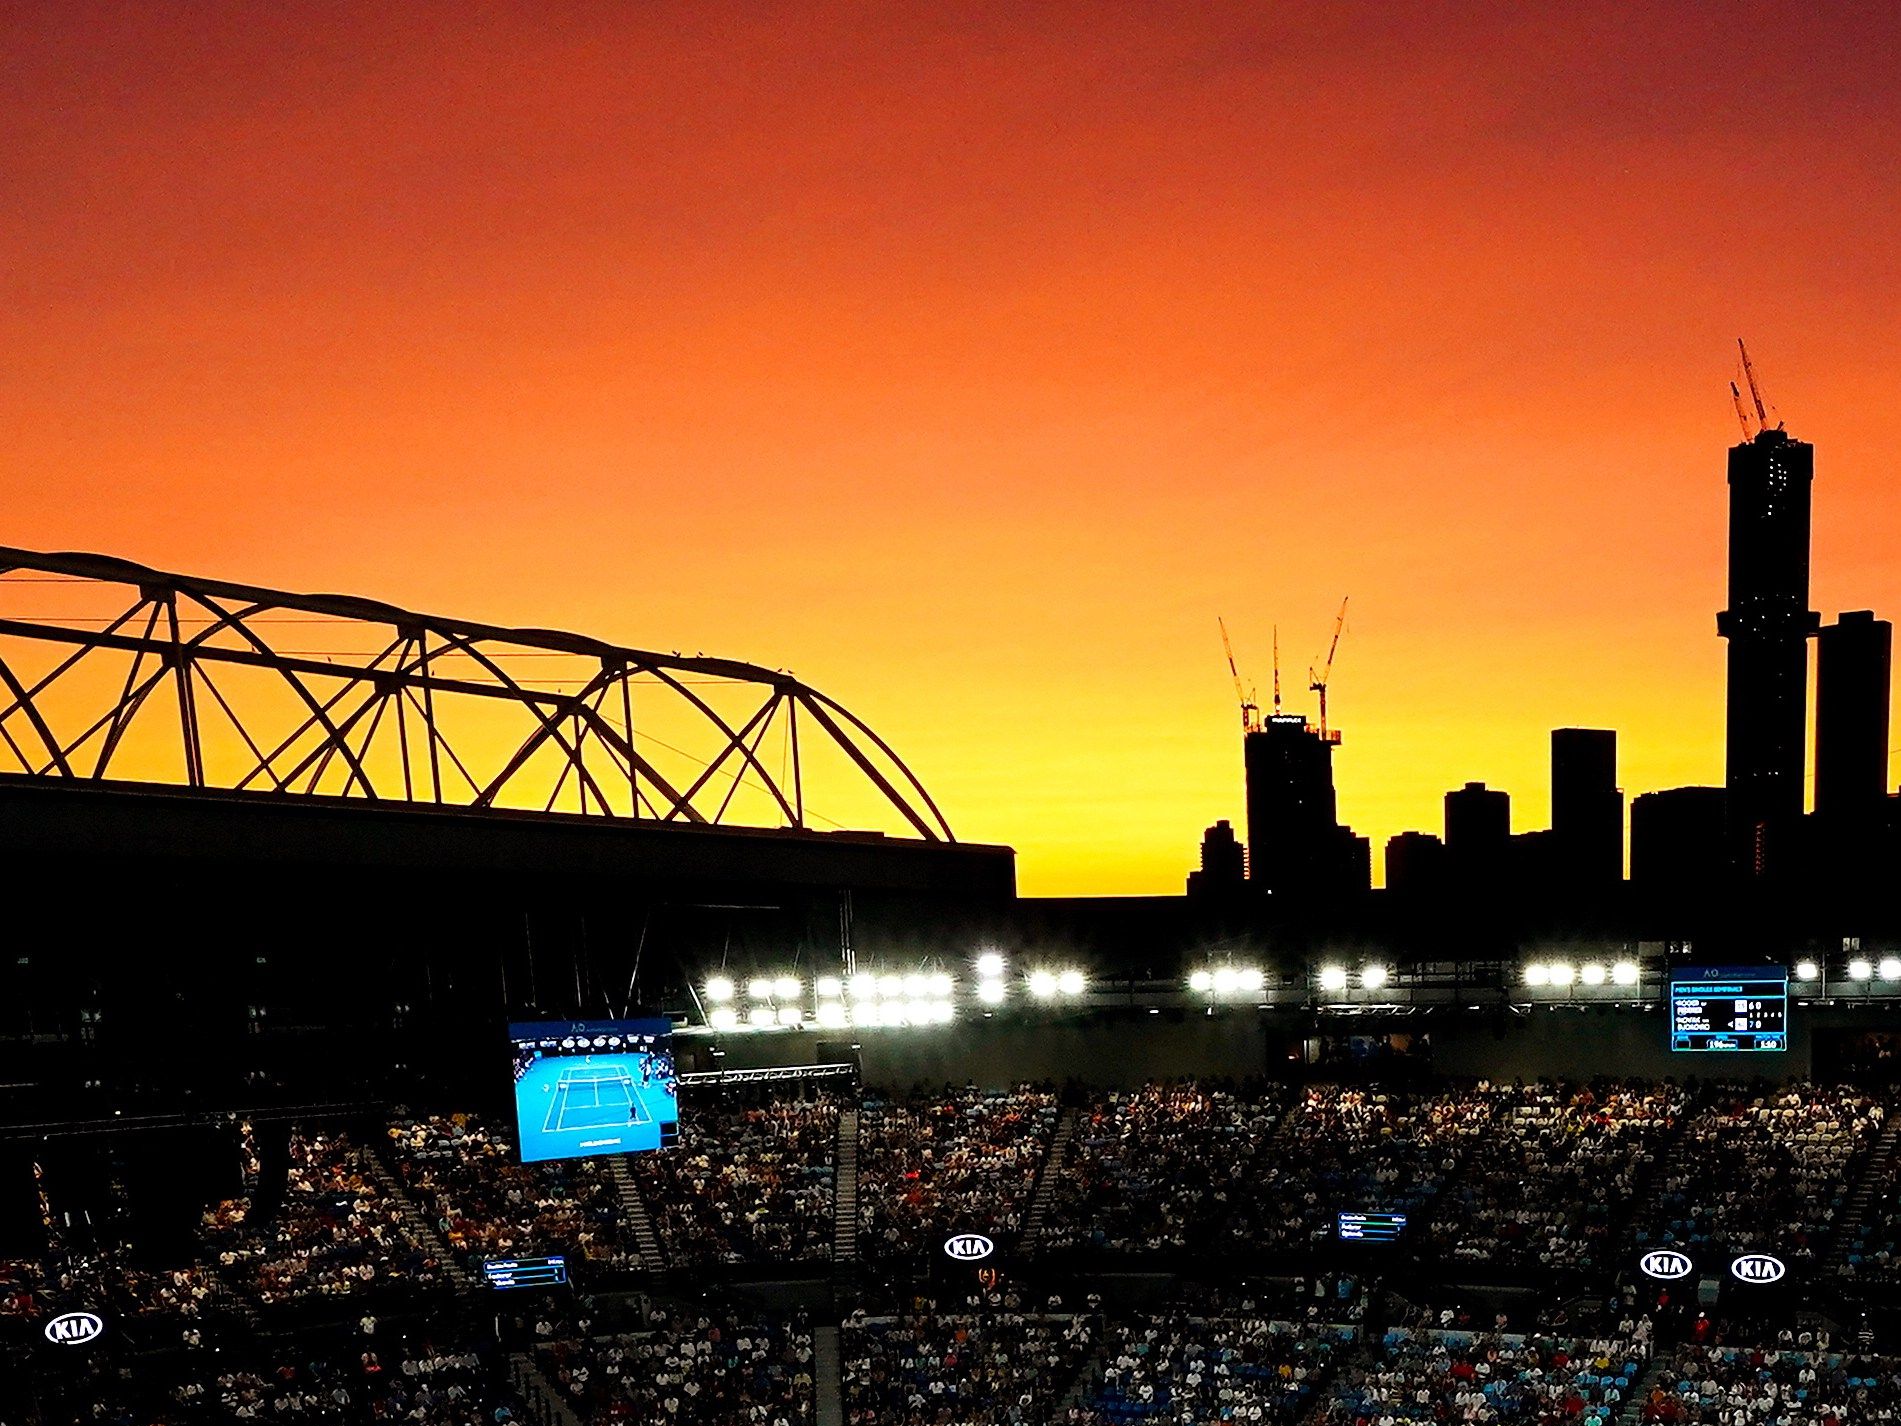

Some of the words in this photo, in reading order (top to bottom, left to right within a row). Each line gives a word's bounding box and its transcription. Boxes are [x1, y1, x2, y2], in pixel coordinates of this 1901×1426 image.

[952, 1239, 985, 1256] KIA
[1650, 1255, 1682, 1275] KIA
[1741, 1259, 1776, 1279] KIA
[55, 1318, 94, 1340] KIA
